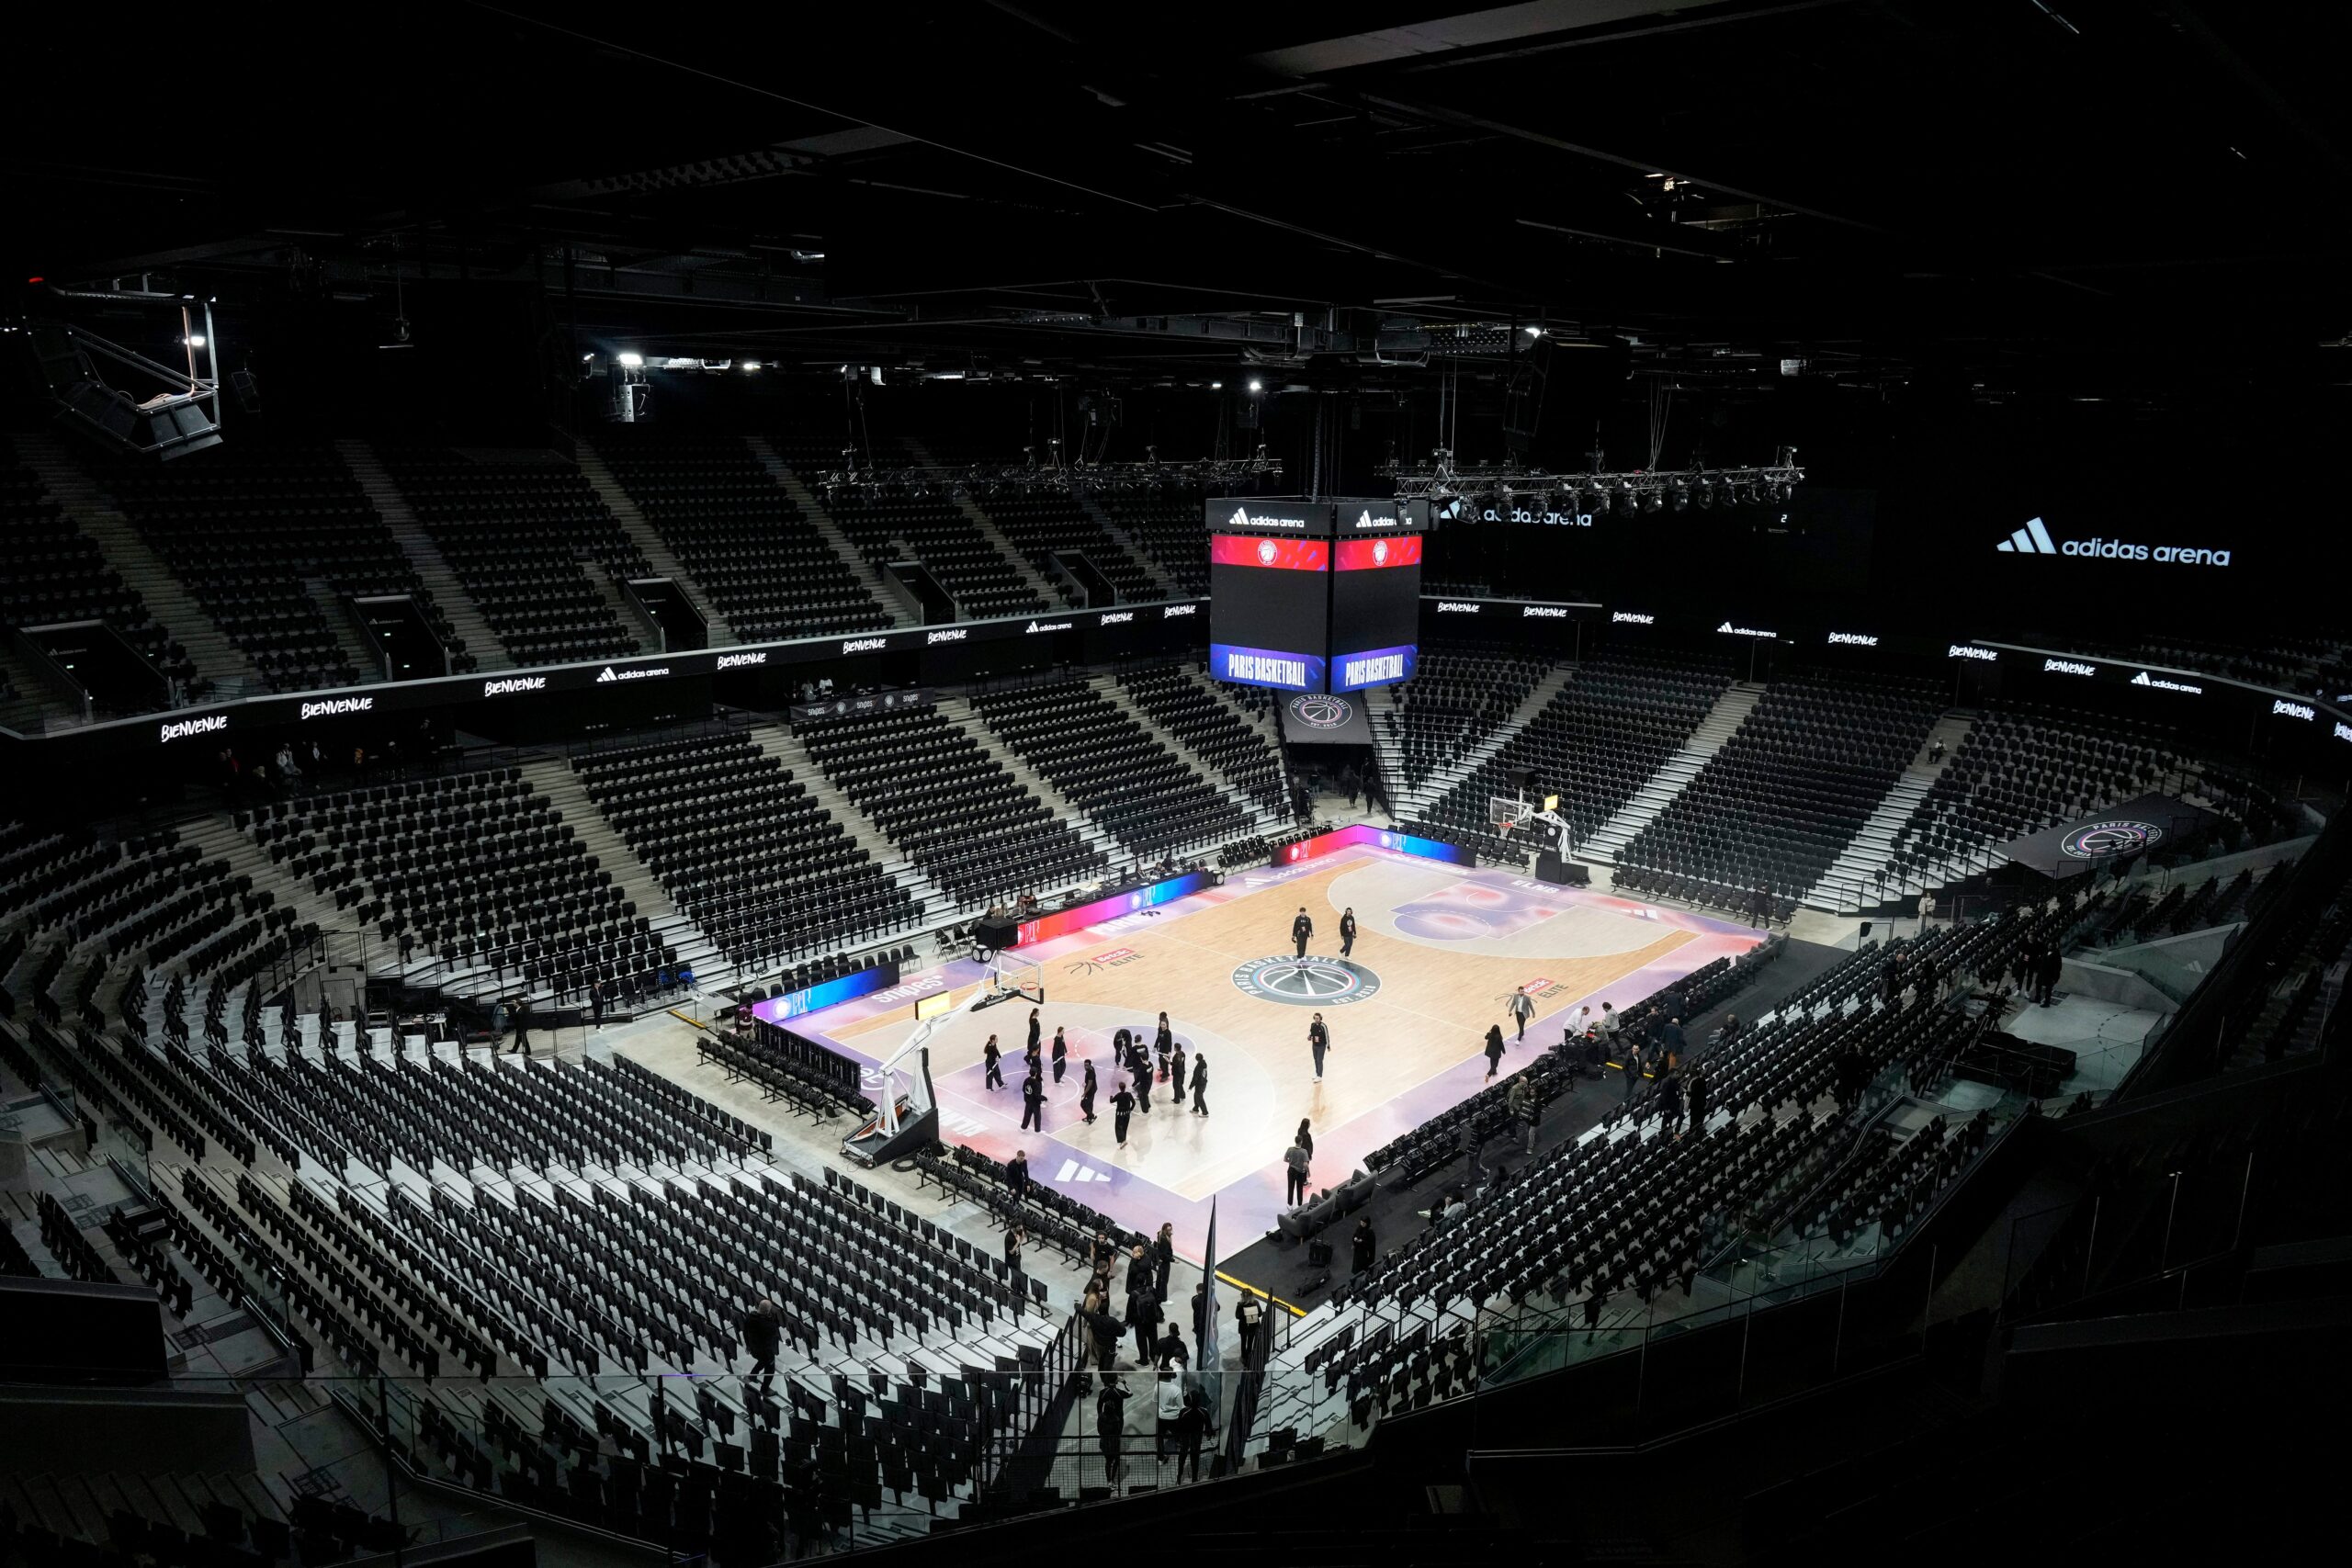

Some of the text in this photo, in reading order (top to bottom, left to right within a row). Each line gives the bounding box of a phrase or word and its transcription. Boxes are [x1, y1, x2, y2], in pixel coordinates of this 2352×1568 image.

[1250, 516, 1305, 528] adidas arena
[1373, 516, 1394, 527] adidas
[2063, 538, 2231, 567] adidas arena
[1164, 604, 1196, 619] BIENVENUE
[1438, 603, 1480, 613] BIENVENUE
[1523, 606, 1567, 618] BIENVENUE
[1102, 612, 1134, 626] BIENVENUE
[1611, 611, 1655, 625] BIENVENUE
[1040, 624, 1057, 632] adidas
[1734, 627, 1777, 638] adidas arena
[928, 628, 967, 645] BIENVENUE
[1827, 631, 1879, 647] BIENVENUE
[842, 637, 887, 654] BIENVENUE
[1948, 645, 1998, 661] BIENVENUE
[717, 651, 766, 671] BIENVENUE
[2043, 659, 2096, 677] BIENVENUE
[617, 668, 670, 681] adidas arena
[1228, 653, 1306, 687] PARIS BASKETBALL
[1345, 653, 1404, 687] PARIS BASKETBALL
[484, 676, 547, 697] BIENVENUE
[2151, 680, 2202, 694] adidas arena
[300, 697, 373, 720] BIENVENUE
[161, 716, 228, 743] BIENVENUE
[2092, 822, 2131, 830] PARIS
[1234, 955, 1340, 996] PARIS BASKETALL
[871, 976, 944, 1004] snipes
[1331, 996, 1357, 1005] EST.
